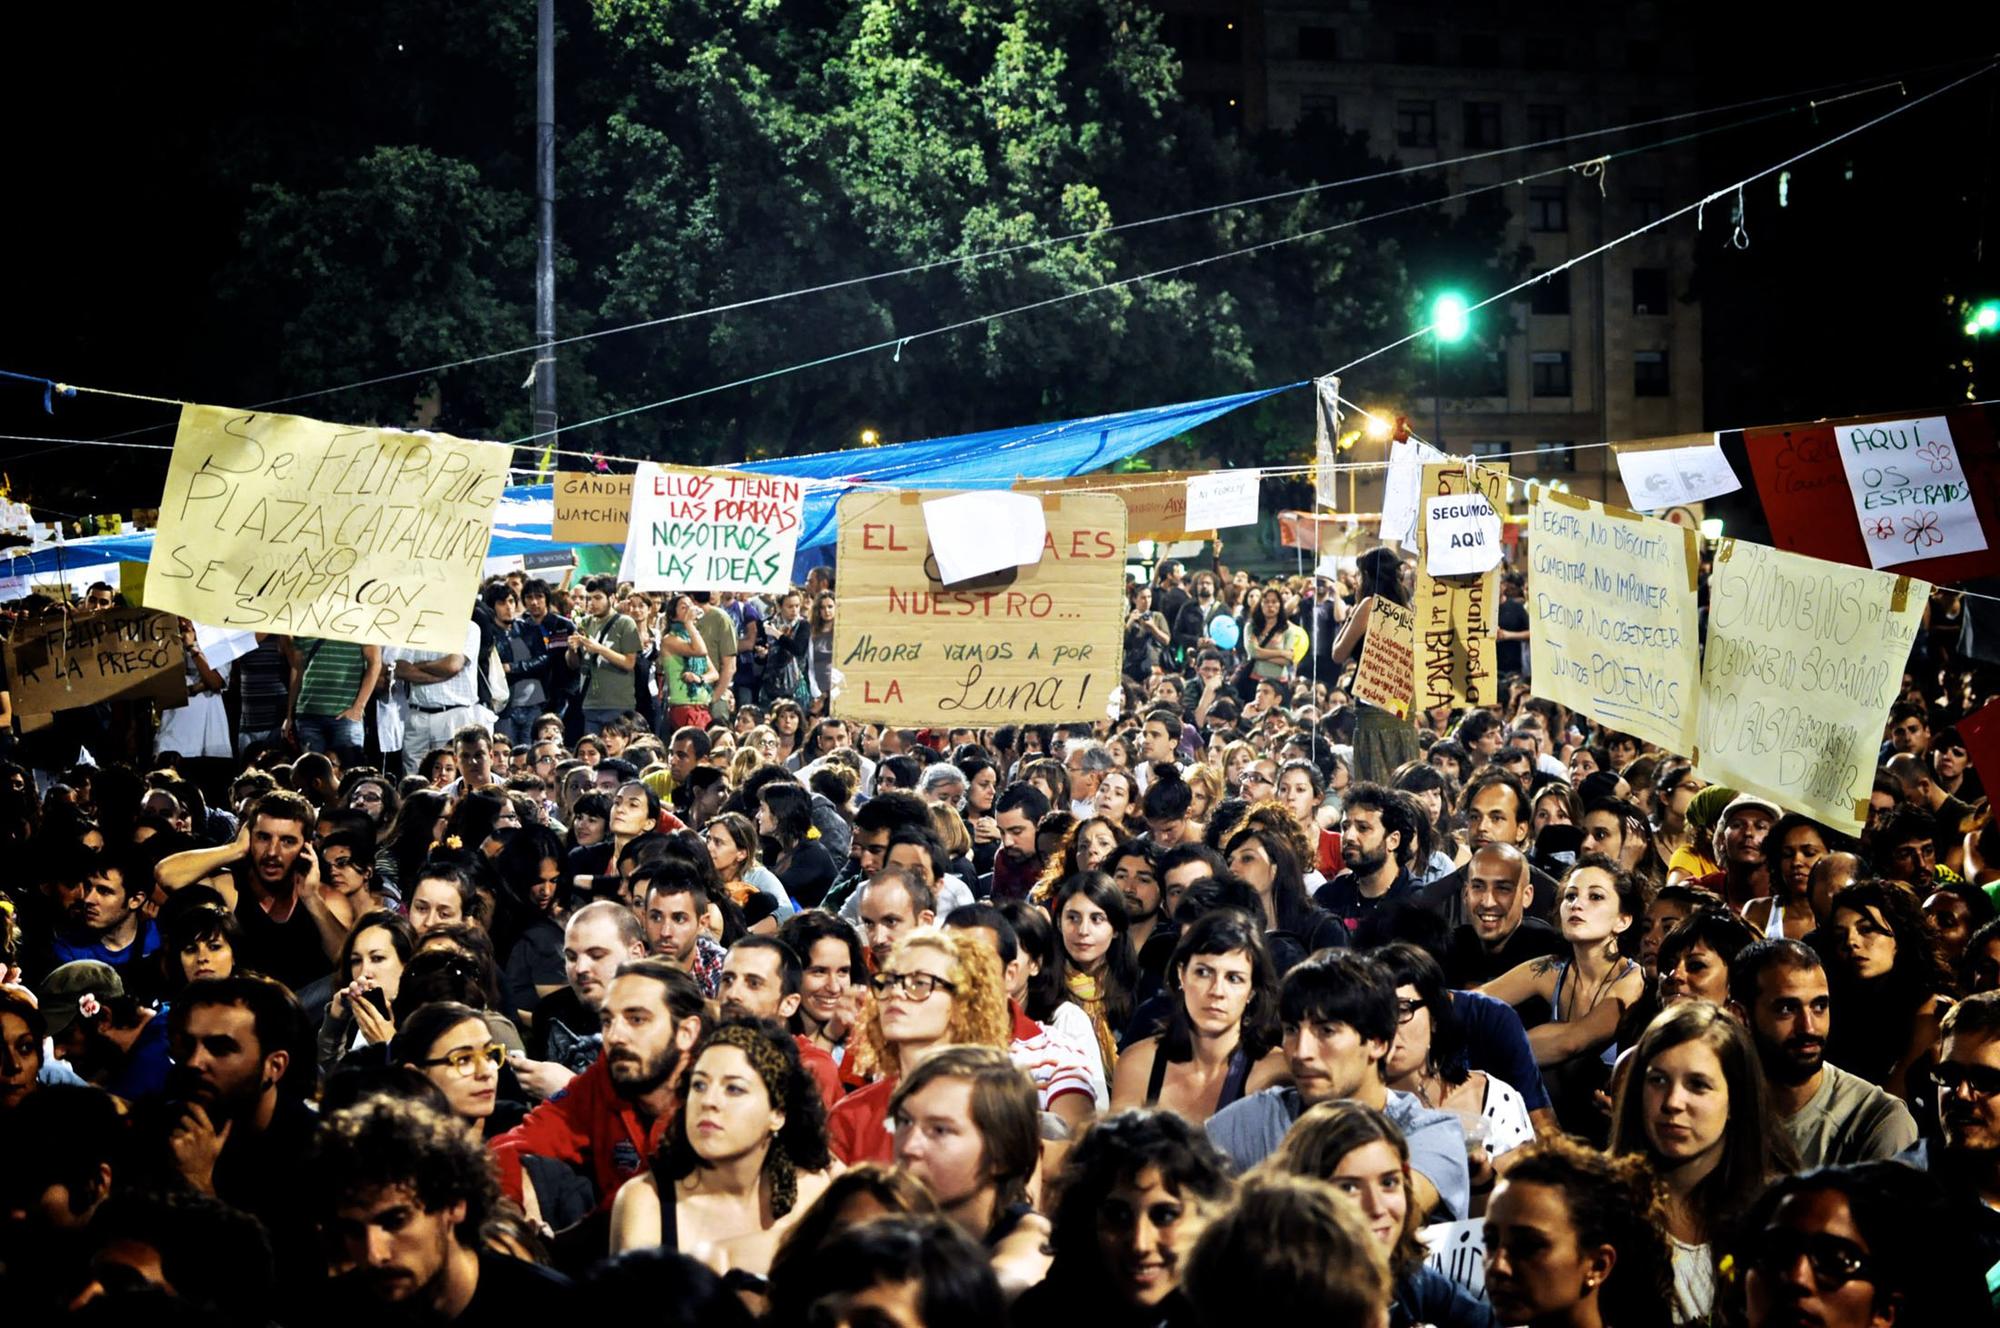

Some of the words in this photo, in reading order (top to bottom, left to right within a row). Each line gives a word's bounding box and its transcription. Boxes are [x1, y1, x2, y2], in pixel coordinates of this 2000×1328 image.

[563, 480, 632, 495] GANDH
[654, 474, 714, 499] ELLOS
[725, 476, 798, 502] TIENEN
[1862, 466, 1910, 488] OS
[181, 472, 325, 549] PLAZA
[335, 504, 490, 577] CATALUÑA
[671, 501, 707, 522] LAS
[714, 498, 796, 534] PORRAS
[1432, 504, 1494, 521] SEGUIMOS
[652, 521, 770, 557] NOSOTROS
[863, 524, 909, 552] EL
[1070, 531, 1117, 560] ES
[160, 545, 225, 592] SE
[355, 579, 427, 607] CON
[286, 547, 357, 583] NO
[658, 551, 697, 584] LAS
[707, 552, 780, 585] IDEAS
[224, 597, 444, 644] SANGRE
[22, 661, 40, 685] A
[55, 657, 83, 679] LA
[1591, 653, 1681, 719] PODEMOS
[864, 679, 904, 704] LA
